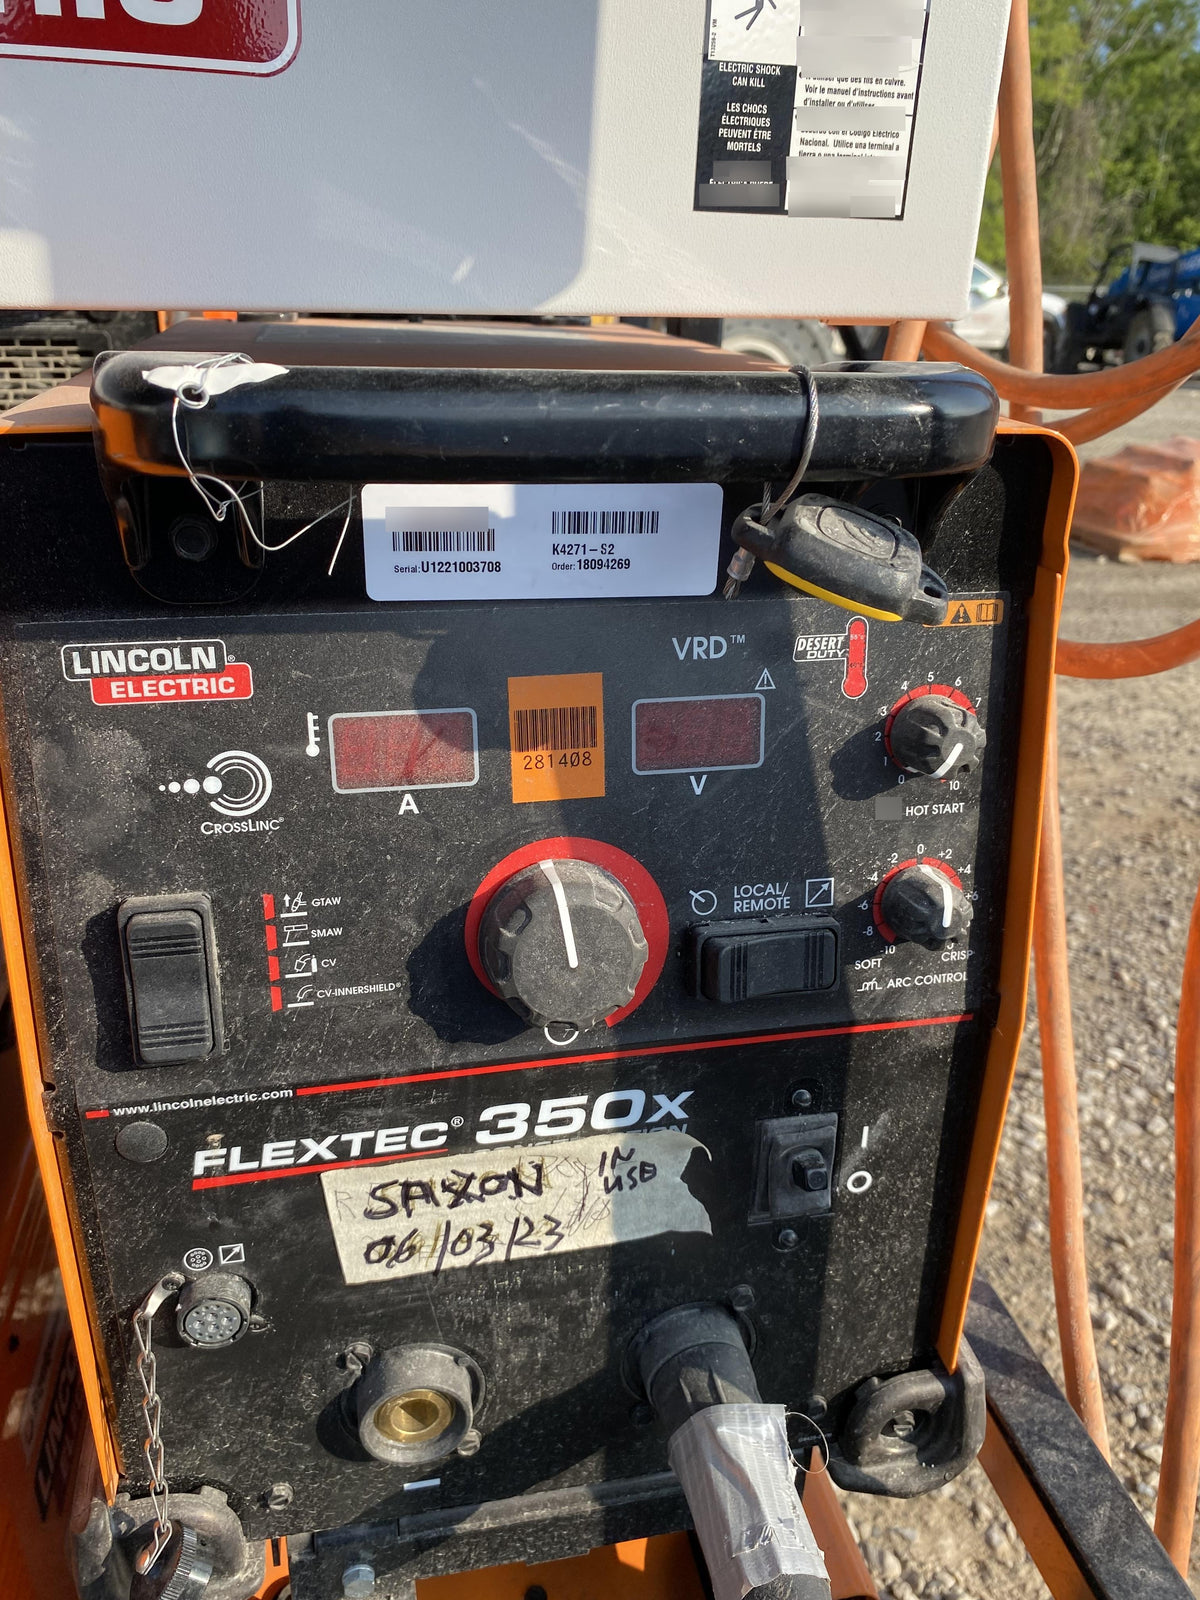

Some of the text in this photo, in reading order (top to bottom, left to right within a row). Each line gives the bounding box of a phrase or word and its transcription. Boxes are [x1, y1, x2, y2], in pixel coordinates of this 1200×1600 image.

[719, 62, 781, 75] ELECTRIC SHOCK
[732, 76, 765, 88] CAN KILL
[805, 84, 914, 100] Voir le manuel d'instructions avant
[726, 102, 768, 115] LES CHOCS
[721, 113, 771, 128] ÉLECTRIQUES
[718, 127, 752, 139] PEUVENT
[726, 141, 761, 152] MORTELS
[799, 137, 829, 147] Nacional.
[833, 140, 854, 149] Utilice
[854, 141, 867, 149] una
[868, 141, 894, 151] terminal
[576, 558, 631, 571] 18094269
[797, 636, 845, 651] DESERT
[806, 649, 845, 659] DUTY
[927, 672, 935, 682] 5
[954, 676, 962, 687] 6
[110, 676, 236, 699] ELECTRIC
[900, 681, 908, 691] 4
[975, 697, 982, 708] 7
[880, 706, 887, 717] 3
[875, 731, 882, 742] 2
[523, 751, 592, 770] 281408
[883, 756, 888, 766] 1
[689, 775, 708, 796] V
[898, 774, 960, 791] 0 10
[398, 793, 420, 815] A
[905, 803, 966, 817] HOT START
[917, 844, 924, 855] 0
[938, 849, 953, 859] +2
[887, 853, 899, 864] -2
[957, 864, 971, 875] +4
[867, 872, 878, 882] -4
[734, 881, 789, 899] LOCAL/
[965, 891, 979, 901] +6
[311, 896, 342, 907] GTAW
[733, 896, 791, 913] REMOTE
[857, 901, 869, 911] -6
[311, 927, 343, 938] SMAW
[862, 926, 874, 936] -8
[880, 945, 896, 955] -10
[941, 950, 973, 962] CRISP
[321, 958, 337, 968] CV
[854, 958, 883, 971] SOFT
[886, 972, 968, 989] ARC CONTROL
[113, 1088, 294, 1117] www.lincolnelectric.com
[598, 1146, 636, 1178] IN
